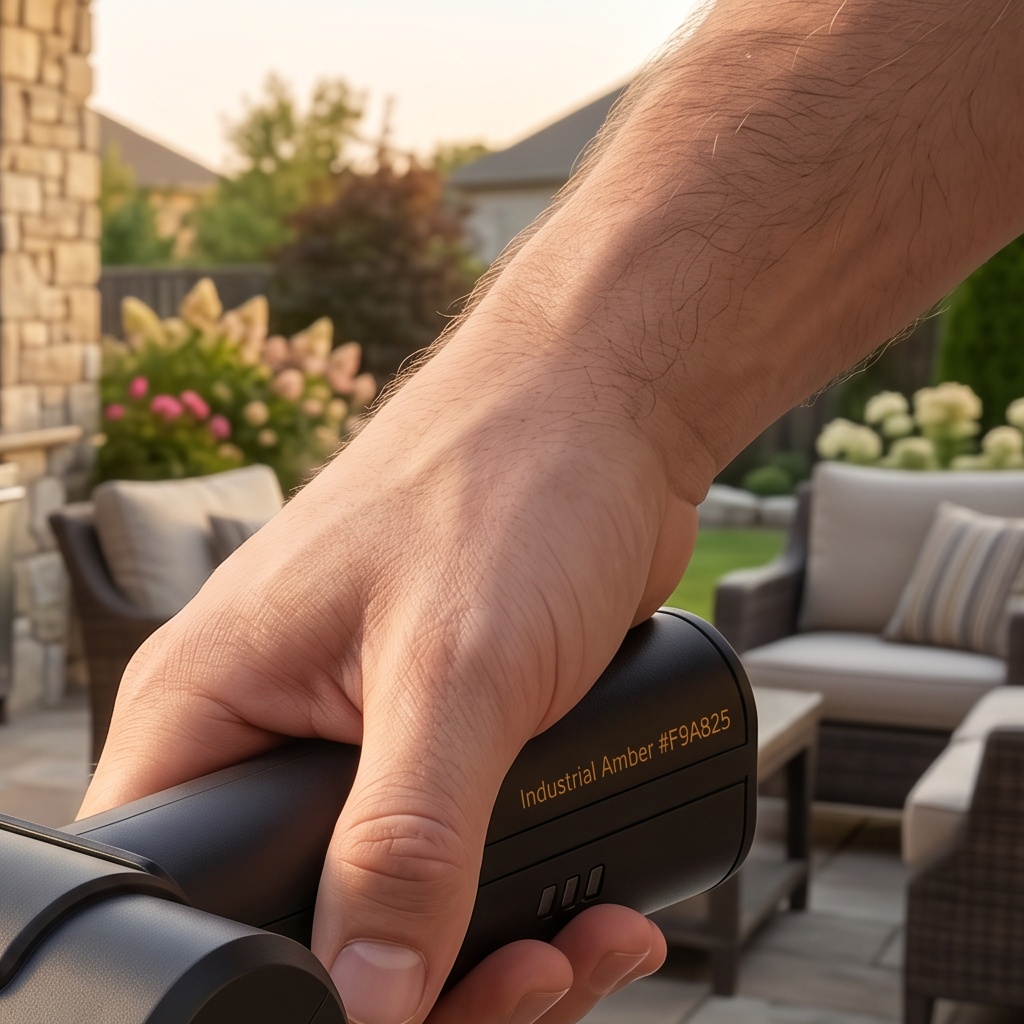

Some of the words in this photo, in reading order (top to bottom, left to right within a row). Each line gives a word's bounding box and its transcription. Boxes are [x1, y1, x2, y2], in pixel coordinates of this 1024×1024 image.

[520, 760, 597, 809] Industrial
[601, 742, 654, 778] Amber
[658, 708, 732, 755] #F9A825
